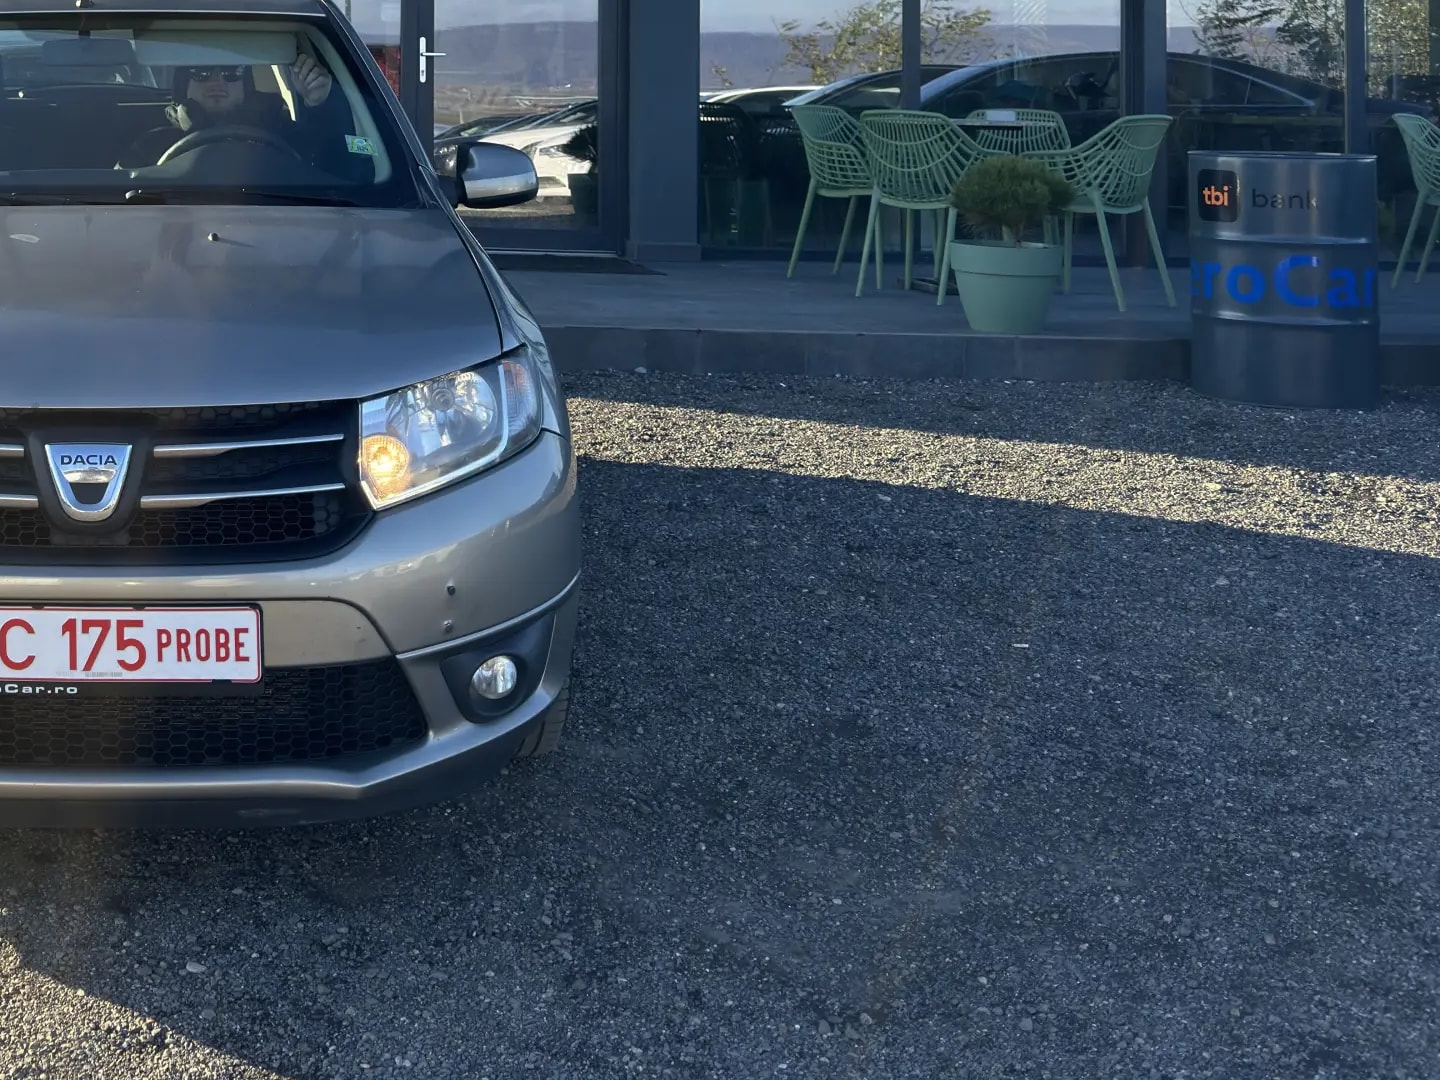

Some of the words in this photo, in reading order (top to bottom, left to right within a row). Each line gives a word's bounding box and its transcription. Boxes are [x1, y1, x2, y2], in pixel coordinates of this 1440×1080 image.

[1202, 185, 1230, 207] tbi
[1251, 188, 1318, 210] bank
[60, 454, 118, 466] DACIA
[61, 617, 147, 672] 175
[156, 627, 251, 663] PROBE
